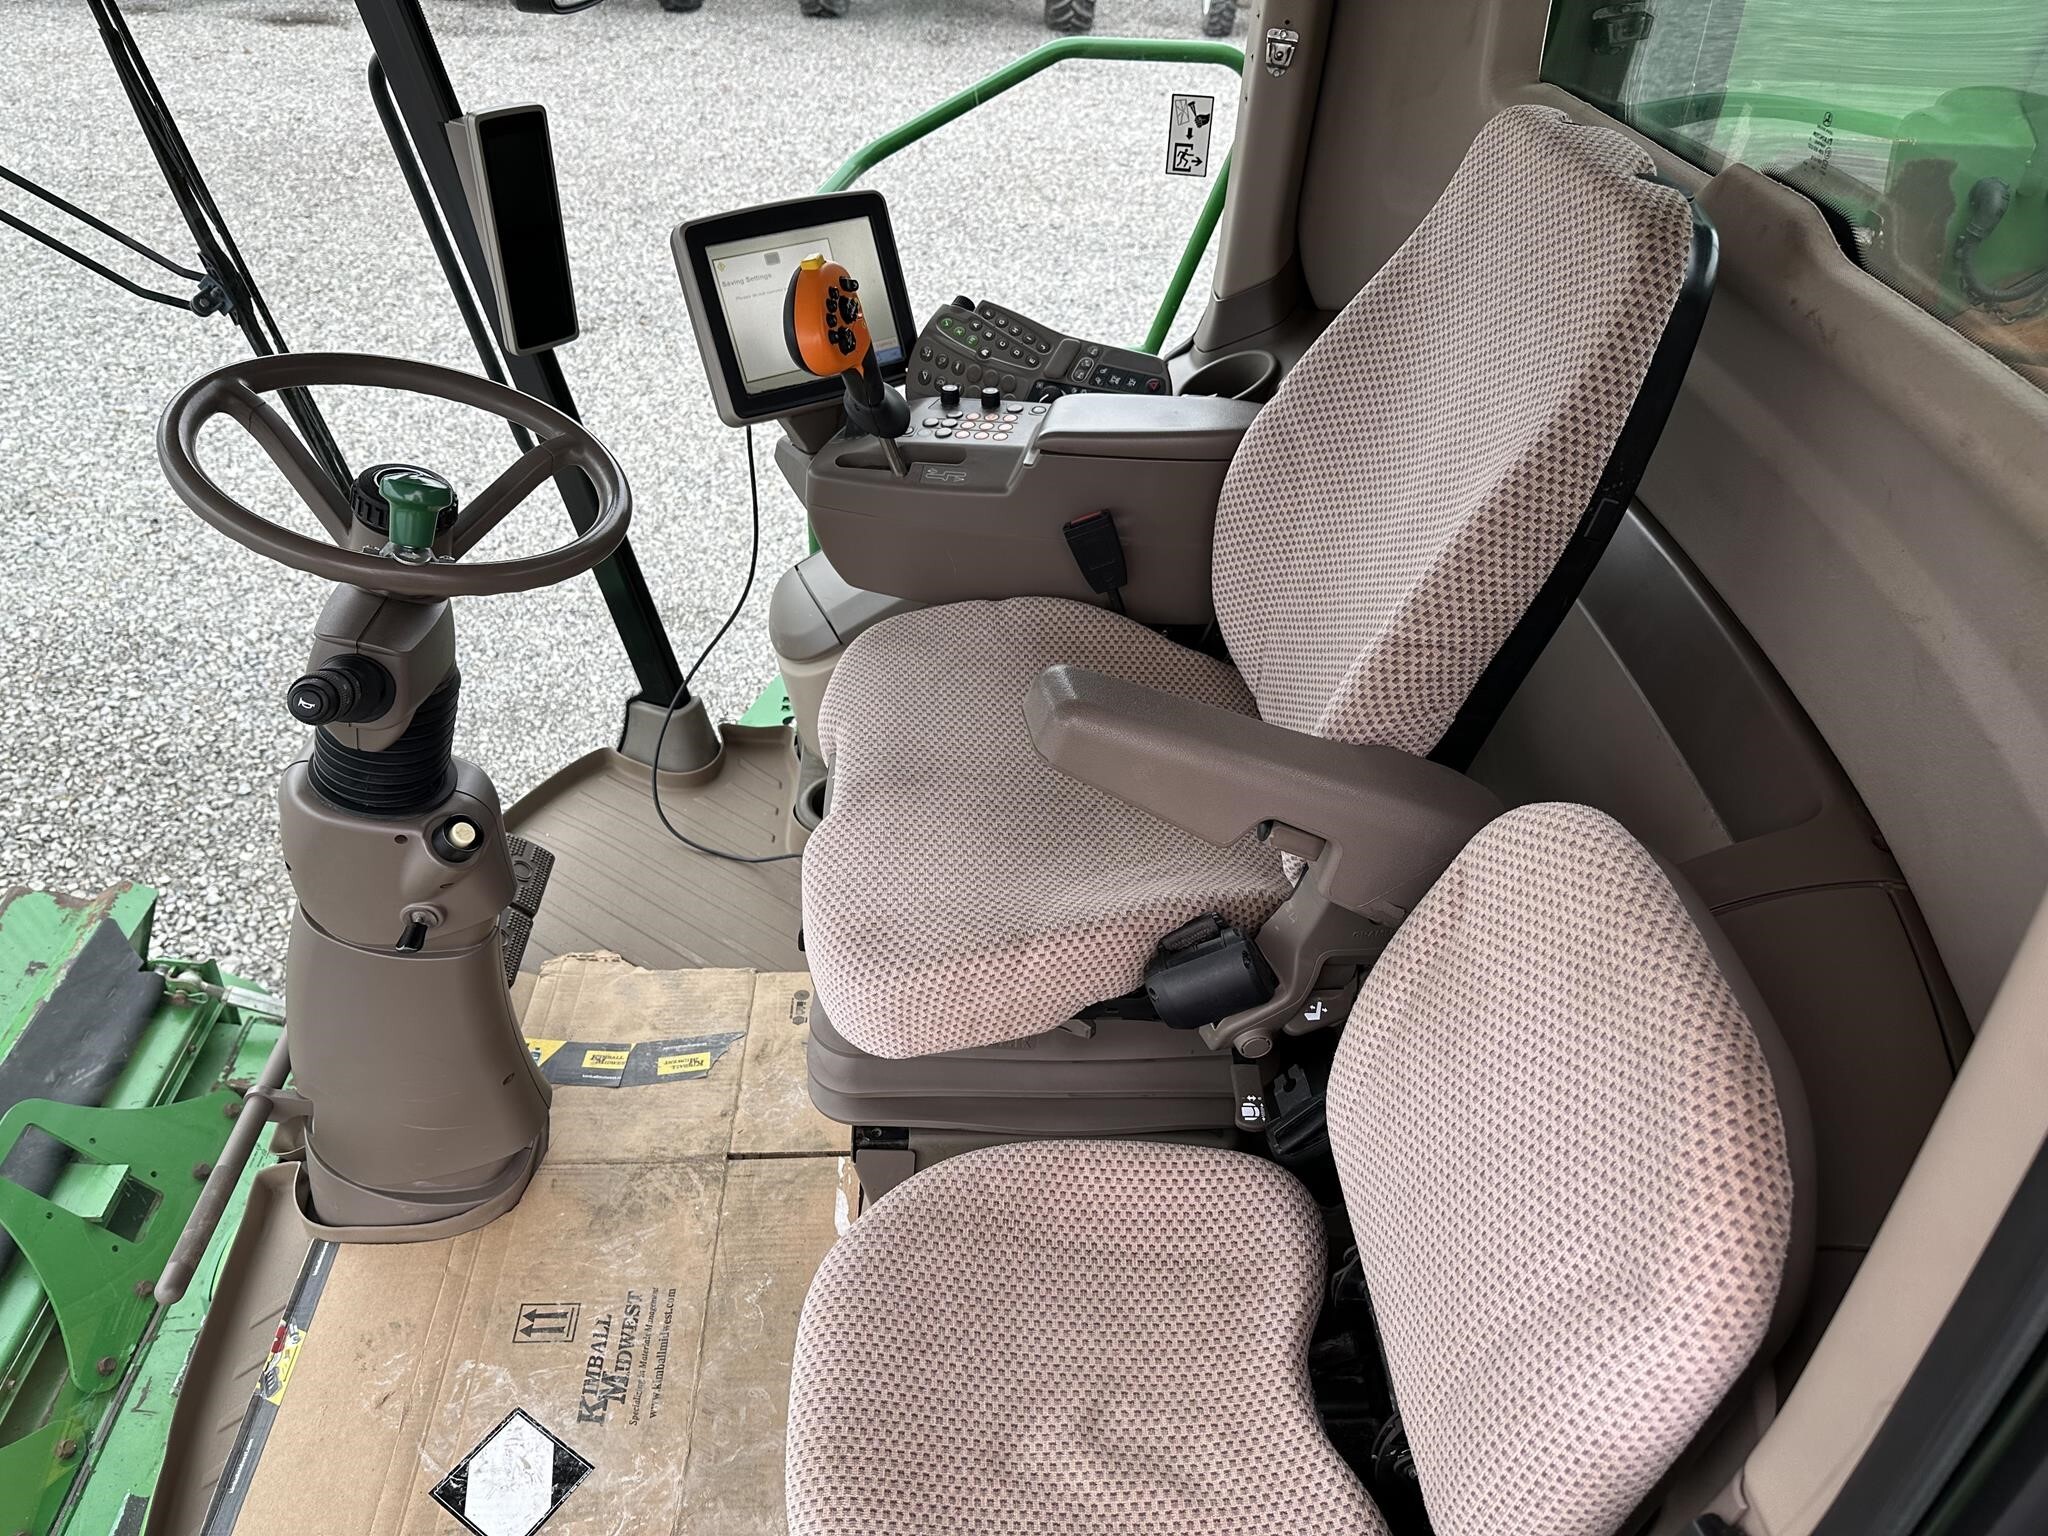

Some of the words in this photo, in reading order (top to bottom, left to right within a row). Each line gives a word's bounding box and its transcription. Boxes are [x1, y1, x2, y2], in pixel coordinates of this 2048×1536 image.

[577, 1313, 612, 1427] KIMBALL
[598, 1290, 643, 1405] MIDWEST
[639, 1334, 652, 1370] Materials
